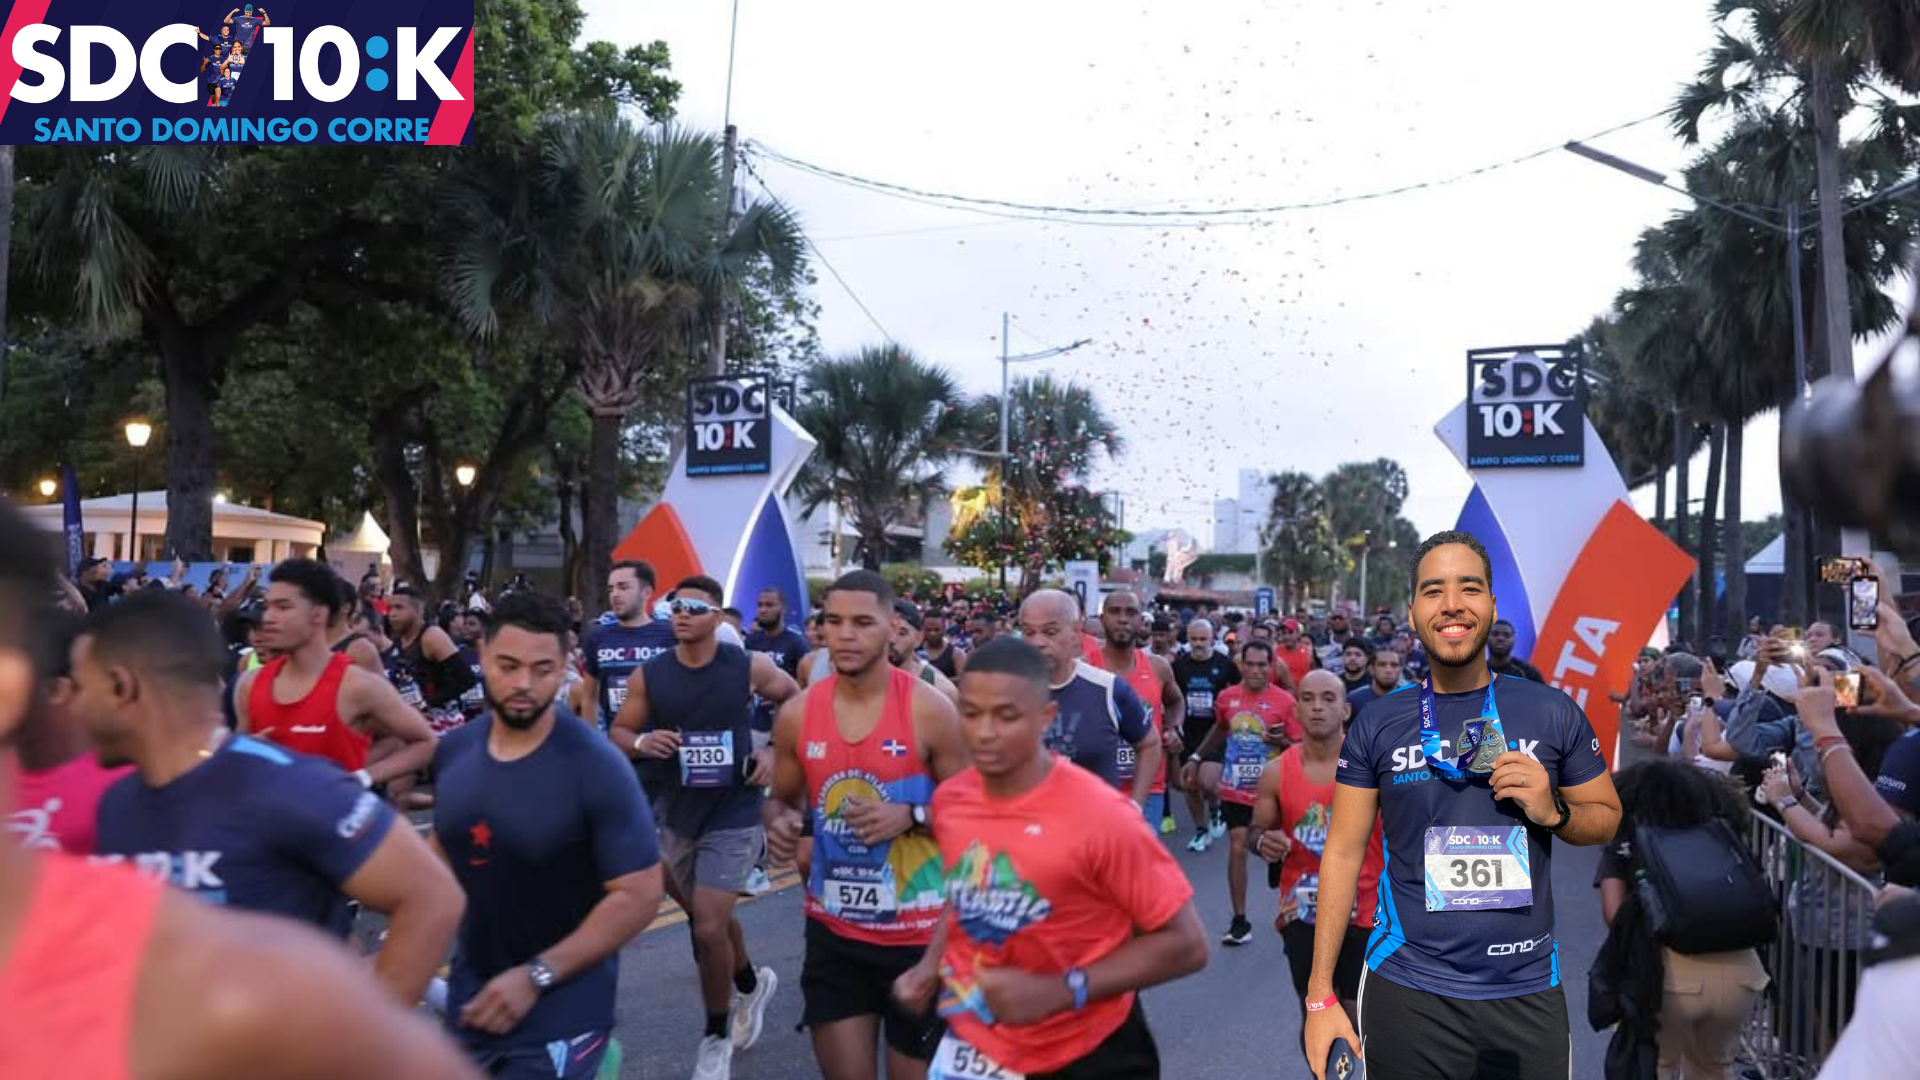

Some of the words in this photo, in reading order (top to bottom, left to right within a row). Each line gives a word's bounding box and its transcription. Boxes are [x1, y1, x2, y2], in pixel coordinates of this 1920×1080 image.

[1481, 361, 1576, 398] SDC
[694, 385, 764, 415] SDC
[1479, 403, 1565, 437] 10:K
[694, 421, 756, 451] 10:K
[686, 749, 725, 764] 2130
[1393, 769, 1431, 786] SANTO
[1434, 767, 1495, 780] DOMING
[1450, 859, 1503, 887] 361
[839, 886, 879, 906] 574
